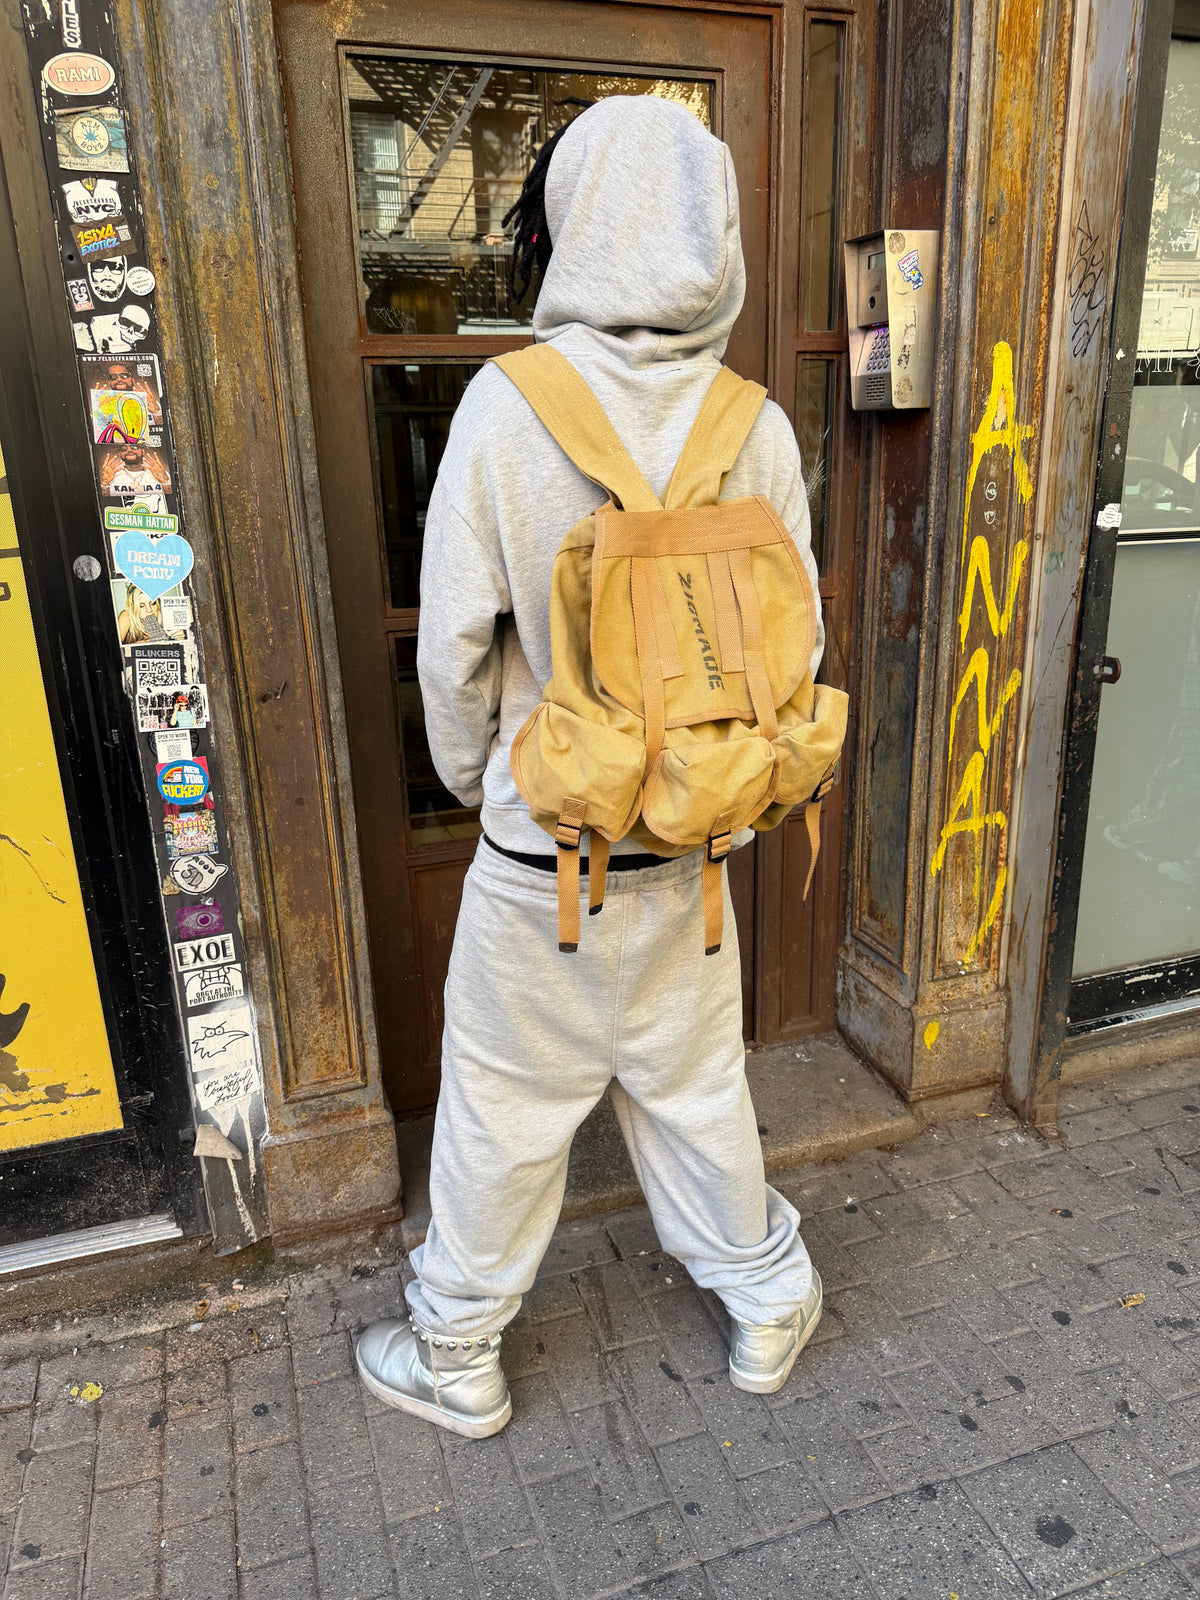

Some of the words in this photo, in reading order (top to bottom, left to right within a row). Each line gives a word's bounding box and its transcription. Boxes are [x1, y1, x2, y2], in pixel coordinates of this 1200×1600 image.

[55, 67, 101, 82] RAMI
[80, 119, 100, 131] ATM
[80, 141, 104, 152] BOYZ
[76, 204, 116, 215] NYC
[109, 513, 143, 528] SESMAN
[145, 516, 175, 530] HATTAN
[126, 550, 181, 567] DREAM
[133, 565, 175, 581] PONY
[135, 649, 180, 659] BLINKERS
[183, 773, 204, 785] YORK
[161, 784, 205, 798] FUCKERY
[207, 988, 243, 1002] AUTHORITY
